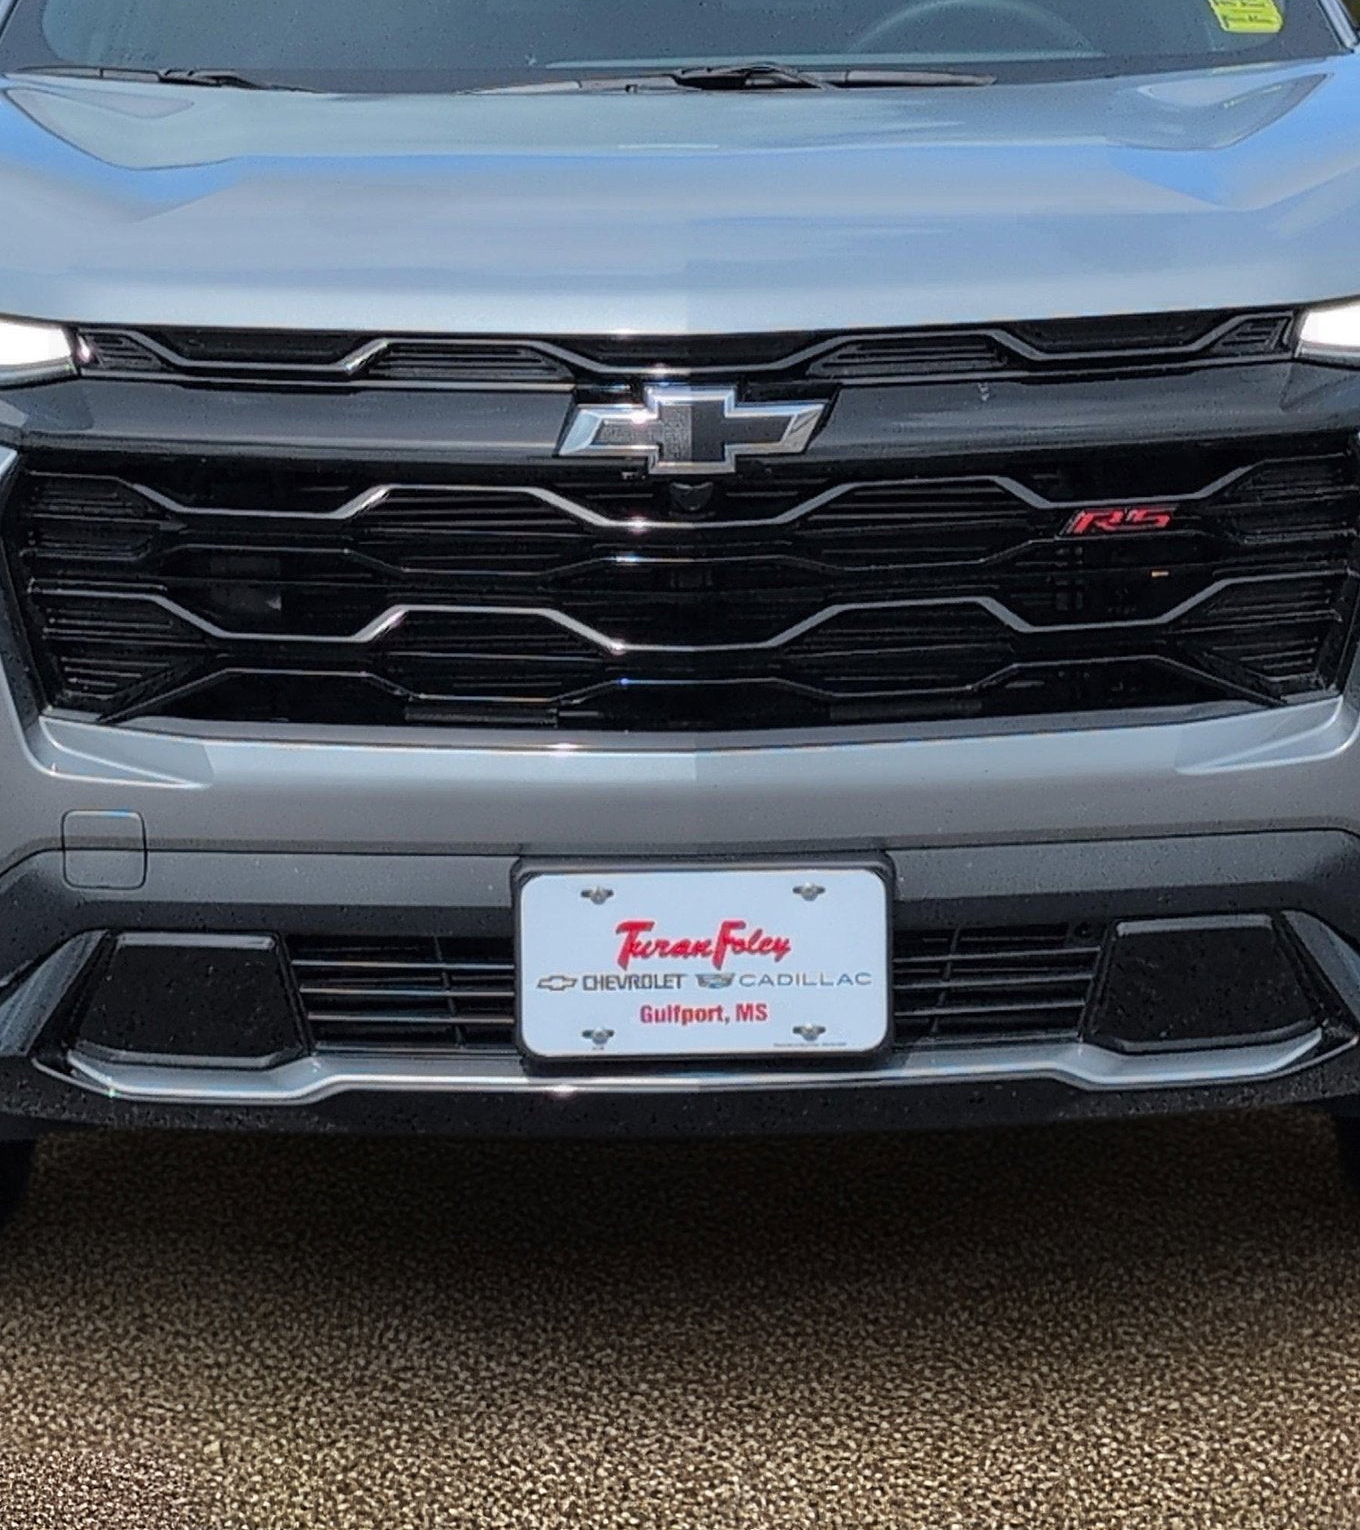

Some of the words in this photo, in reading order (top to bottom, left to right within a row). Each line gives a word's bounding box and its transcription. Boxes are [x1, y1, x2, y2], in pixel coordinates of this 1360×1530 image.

[581, 973, 686, 991] CHEVROLET
[739, 971, 873, 988] CADILLAC
[640, 1003, 730, 1027] Gulfport,
[735, 1002, 768, 1022] MS
